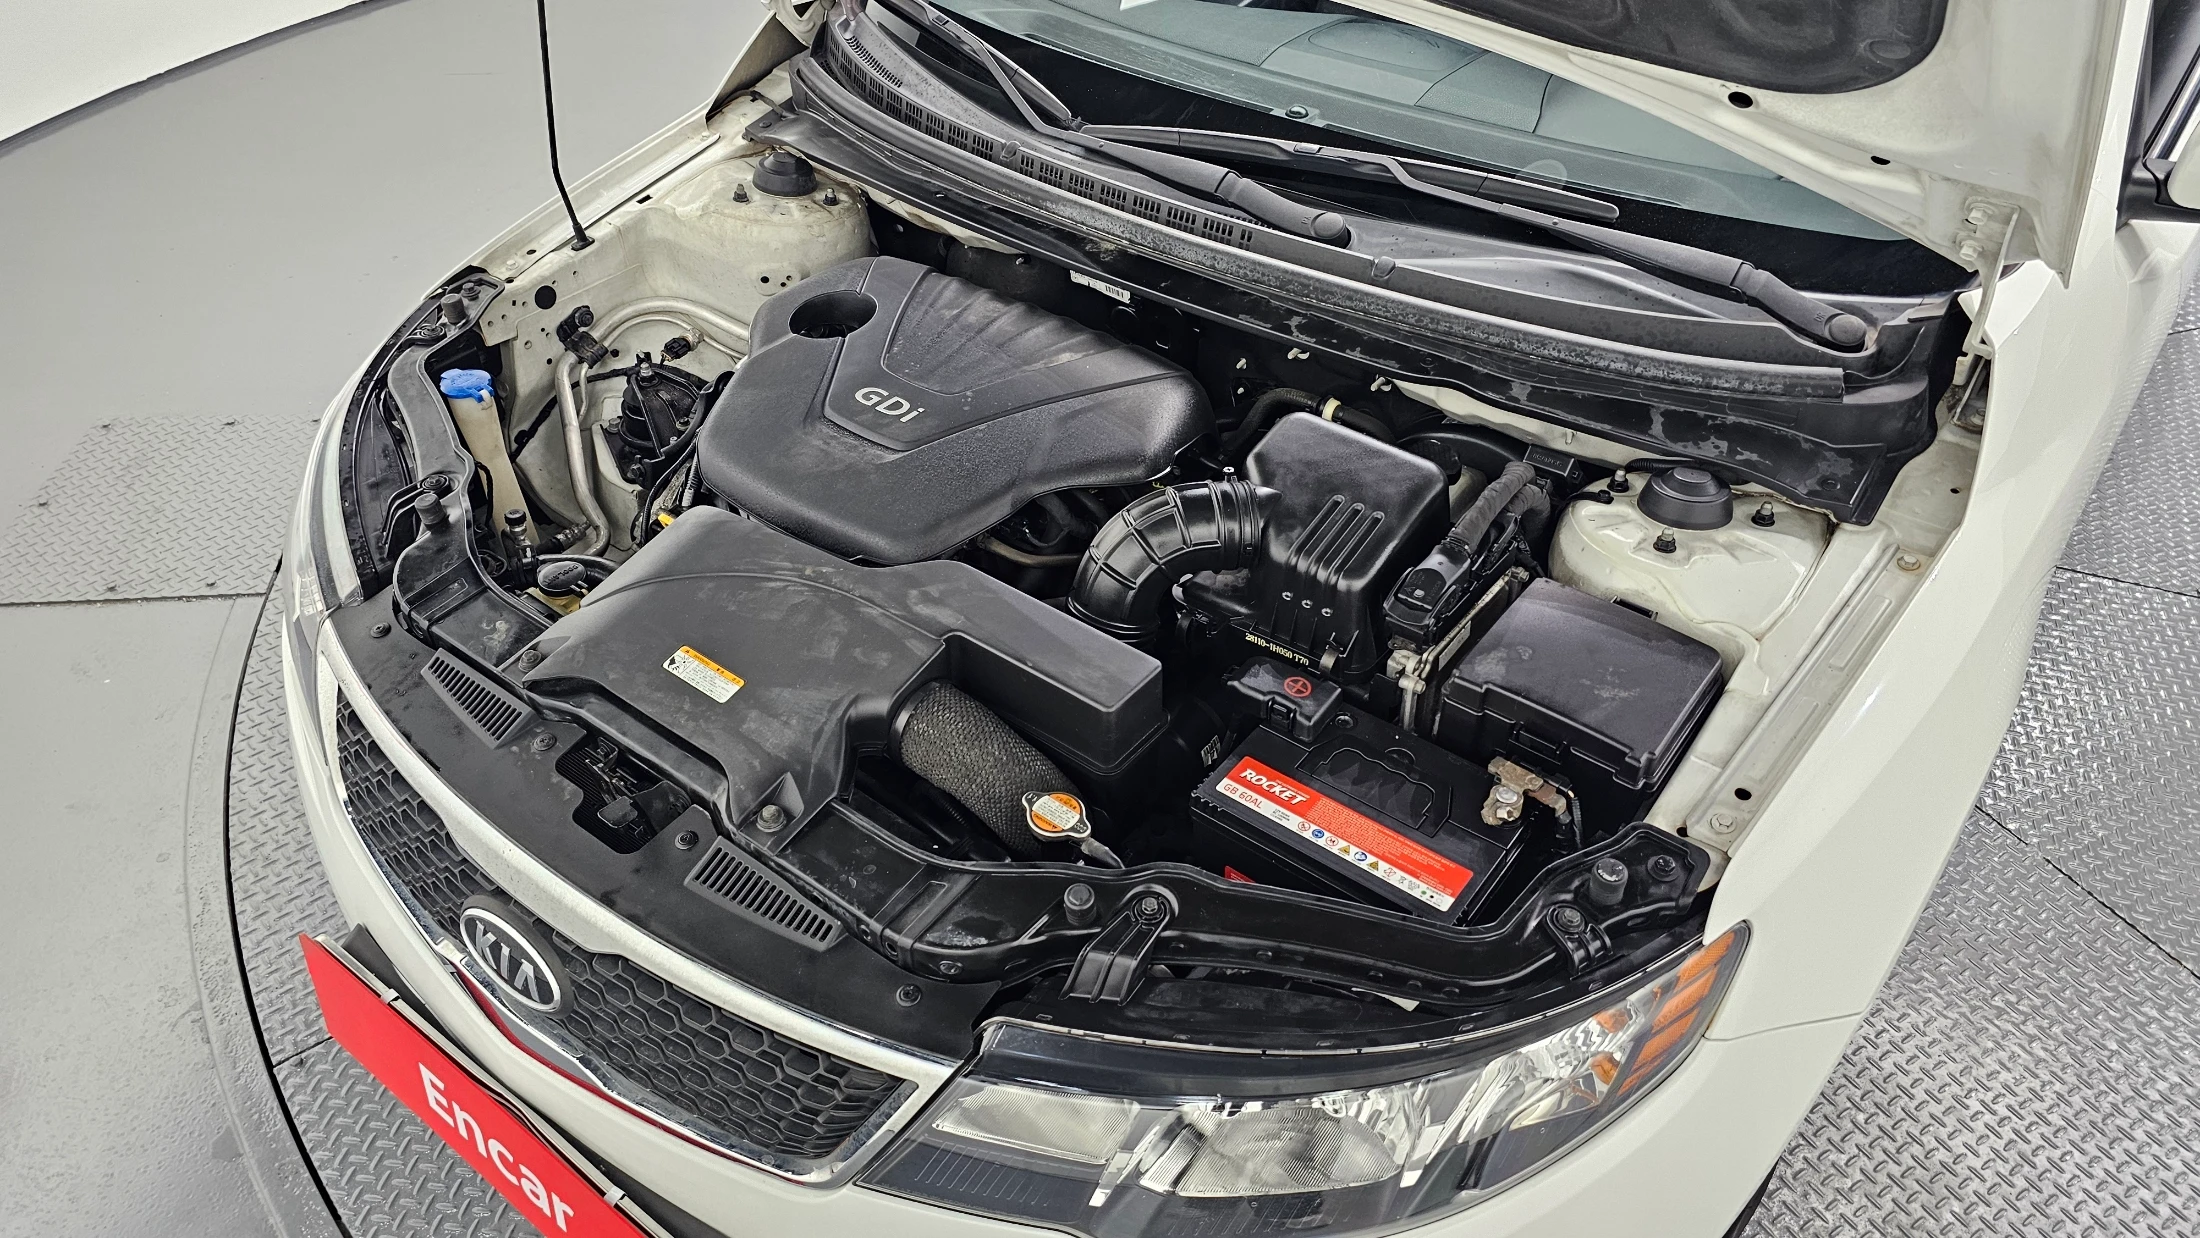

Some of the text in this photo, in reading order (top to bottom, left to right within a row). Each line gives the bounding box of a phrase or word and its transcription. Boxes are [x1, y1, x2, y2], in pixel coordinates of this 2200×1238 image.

[854, 386, 926, 423] GDi
[1245, 632, 1309, 666] 28110-1H050 T70
[1223, 783, 1263, 809] GB 60AL
[1239, 767, 1308, 806] ROCKET
[474, 918, 540, 1003] KIA
[418, 1061, 575, 1233] Encar
